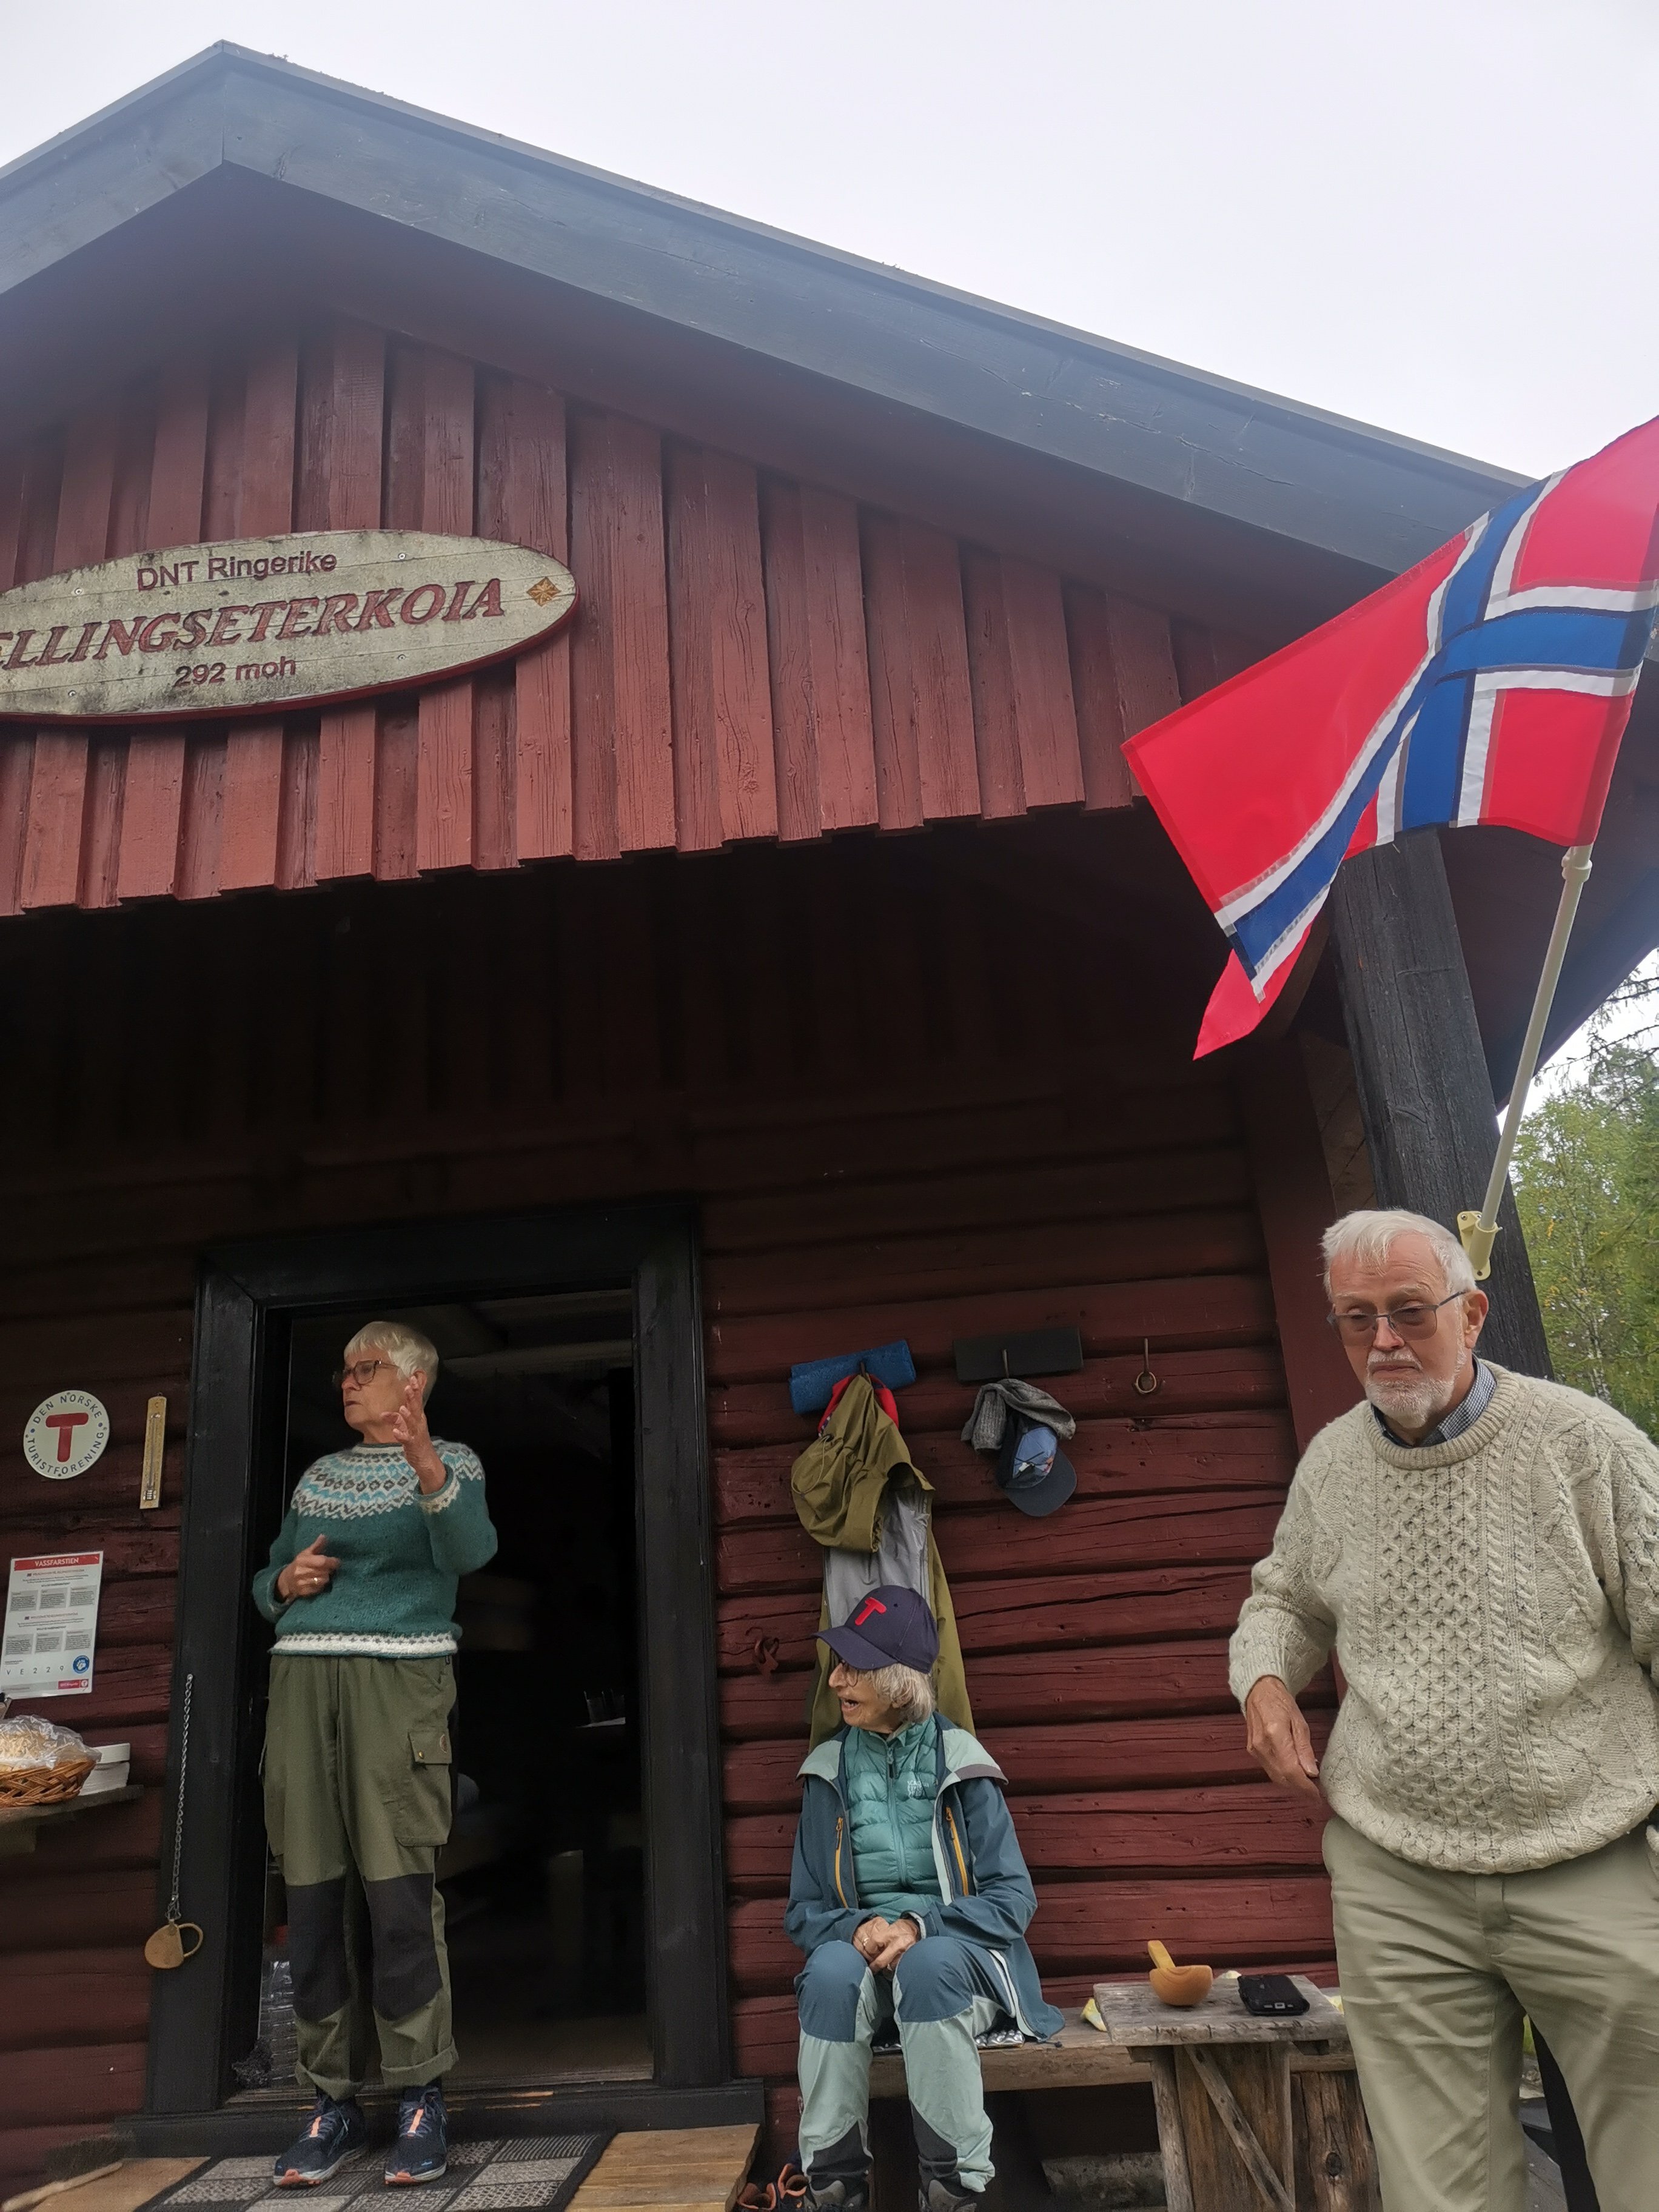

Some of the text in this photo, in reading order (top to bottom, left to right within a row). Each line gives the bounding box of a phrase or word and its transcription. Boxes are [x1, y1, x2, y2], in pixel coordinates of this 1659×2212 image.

[137, 551, 337, 591] DNT Ringerike
[173, 656, 297, 688] 292 moh
[33, 1394, 102, 1424] DEN NORSKE
[45, 1412, 89, 1463] T
[27, 1432, 104, 1476] TURISTFORENING
[35, 1558, 79, 1567] VASSFARSTIEN
[855, 1597, 886, 1625] T
